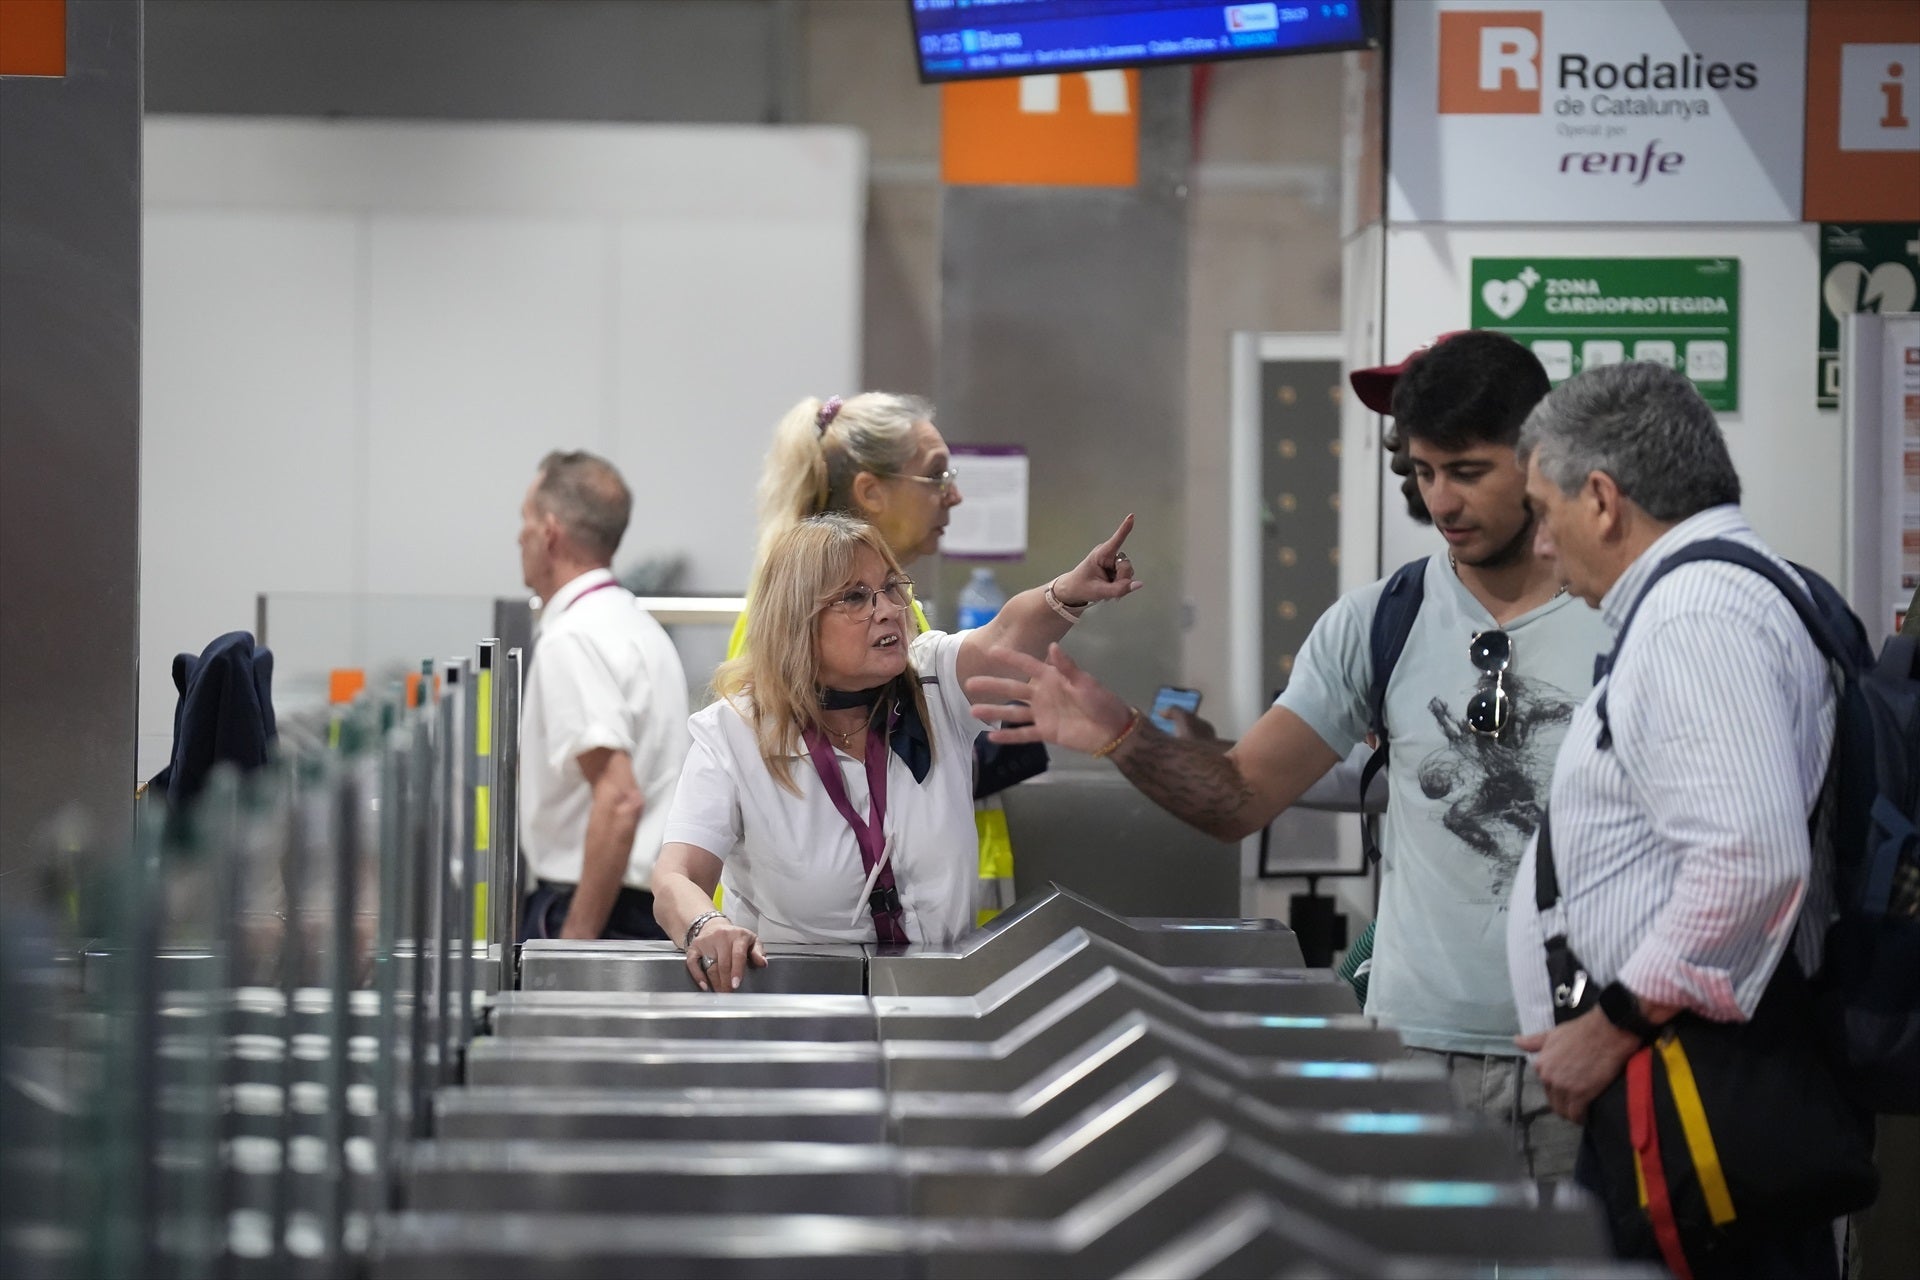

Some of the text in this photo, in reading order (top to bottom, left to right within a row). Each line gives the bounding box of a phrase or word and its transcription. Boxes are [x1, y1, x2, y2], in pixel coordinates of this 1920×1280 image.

[1479, 27, 1539, 91] R
[1559, 54, 1758, 90] Rodalies
[1554, 94, 1710, 121] de Catalunya
[1559, 138, 1685, 186] renfe
[1545, 279, 1728, 314] ZONA CARDIOPROTEGIDA
